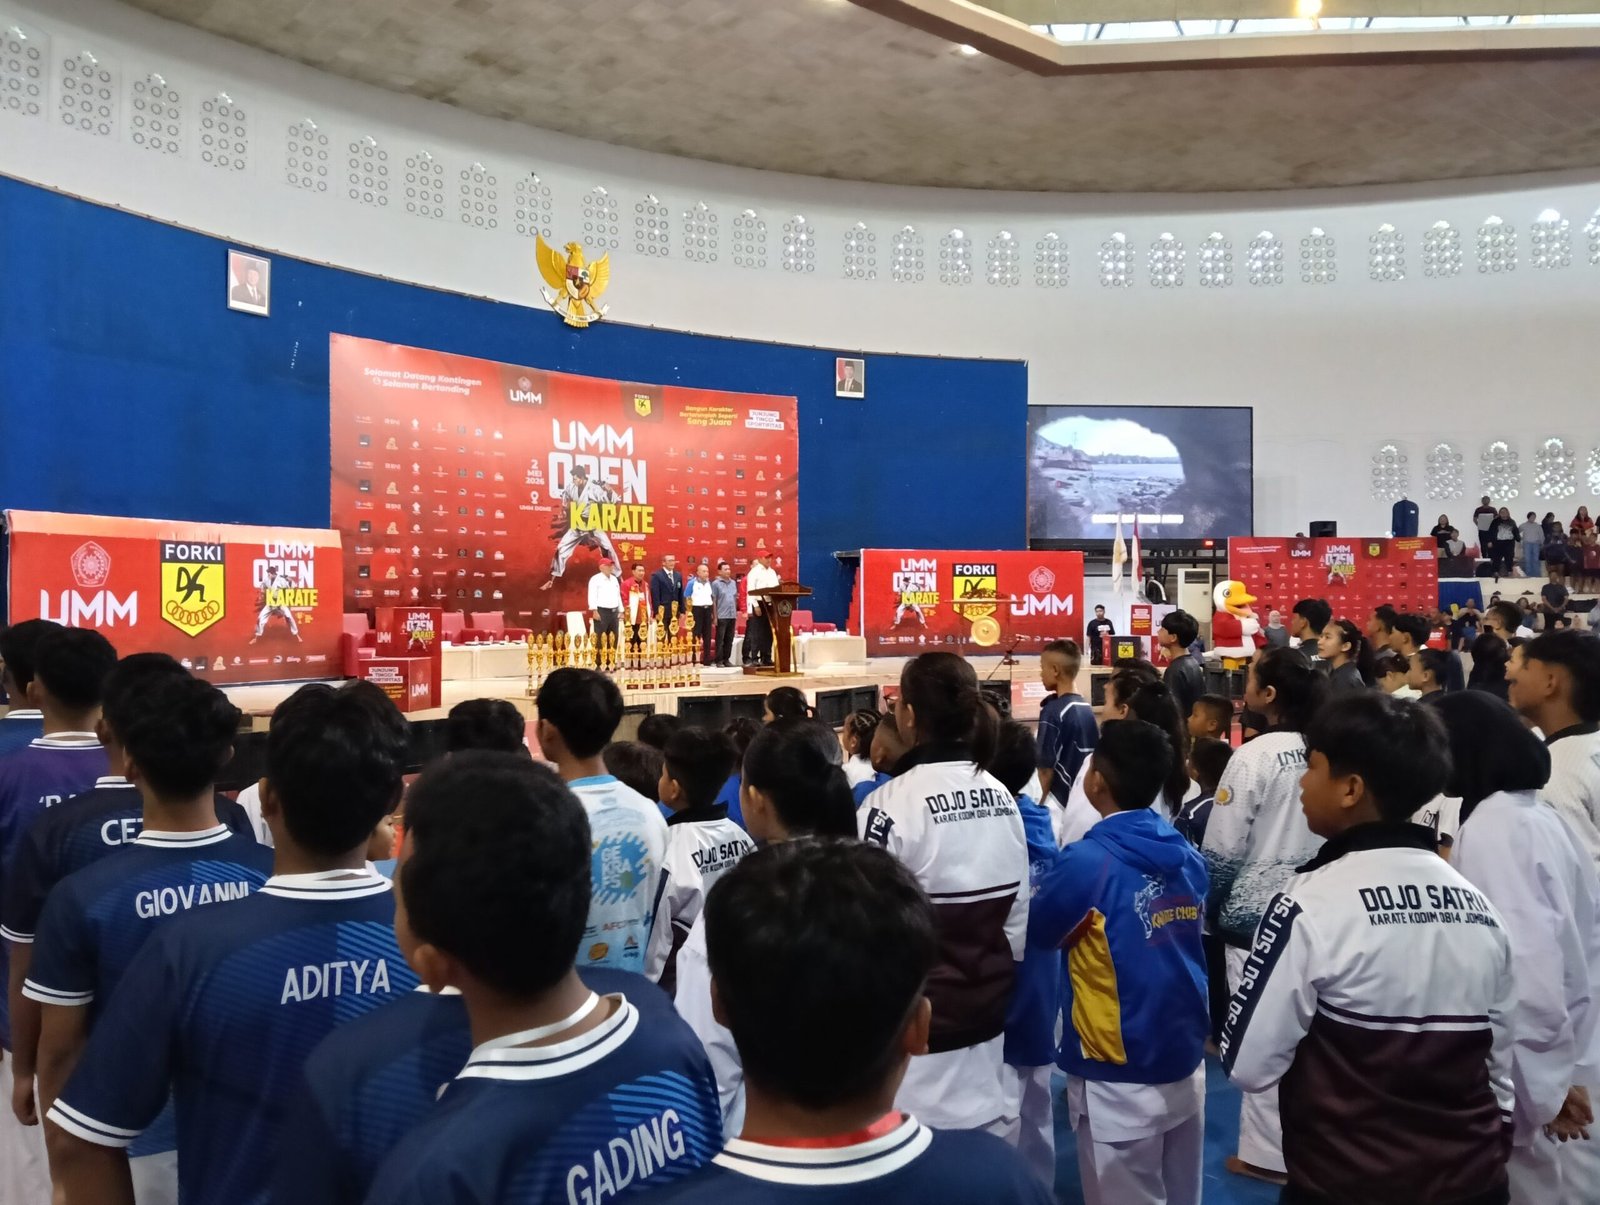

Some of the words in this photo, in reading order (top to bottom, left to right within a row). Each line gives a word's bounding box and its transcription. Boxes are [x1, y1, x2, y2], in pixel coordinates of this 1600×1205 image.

[509, 389, 542, 404] UMM
[552, 418, 634, 456] UMM
[531, 459, 538, 469] 2
[548, 452, 648, 504] OPEN
[570, 501, 654, 533] KARATE
[165, 543, 221, 561] FORKI
[264, 539, 314, 558] UMM
[901, 558, 937, 571] UMM
[955, 565, 995, 575] FORKI
[266, 588, 318, 607] KARATE
[901, 592, 940, 605] KARATE
[1010, 593, 1073, 616] UMM
[40, 589, 138, 628] UMM
[925, 790, 967, 815] DOJO
[934, 812, 958, 825] KARATE
[135, 881, 250, 919] GIOVANNI
[1359, 885, 1422, 912] DOJO
[1426, 885, 1491, 913] SATRIA
[1369, 913, 1407, 926] KARATE
[1409, 912, 1438, 924] KODIM
[280, 958, 391, 1005] ADITYA
[566, 1108, 686, 1205] GADING
